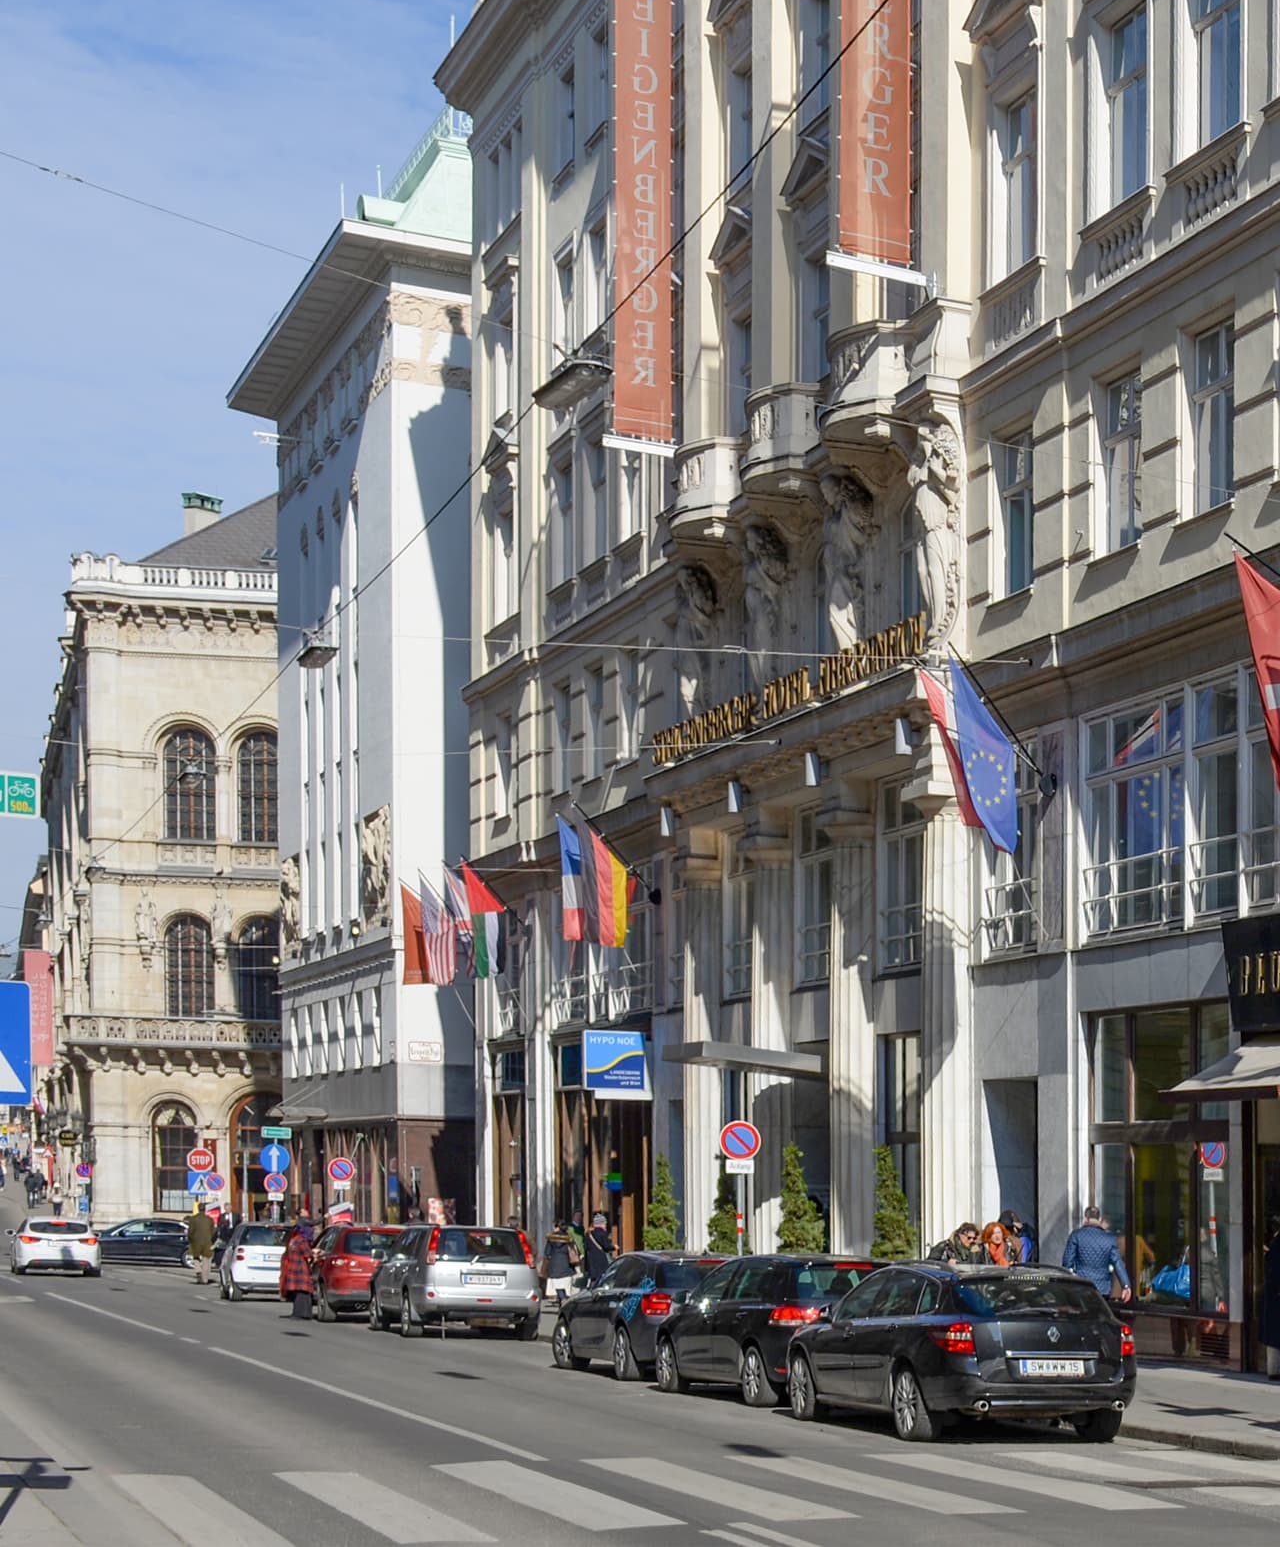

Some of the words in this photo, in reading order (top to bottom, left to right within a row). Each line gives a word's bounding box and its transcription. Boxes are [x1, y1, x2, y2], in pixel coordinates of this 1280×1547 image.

[590, 1036, 615, 1045] HYPO
[617, 1037, 636, 1045] NOE
[191, 1155, 211, 1165] STOP
